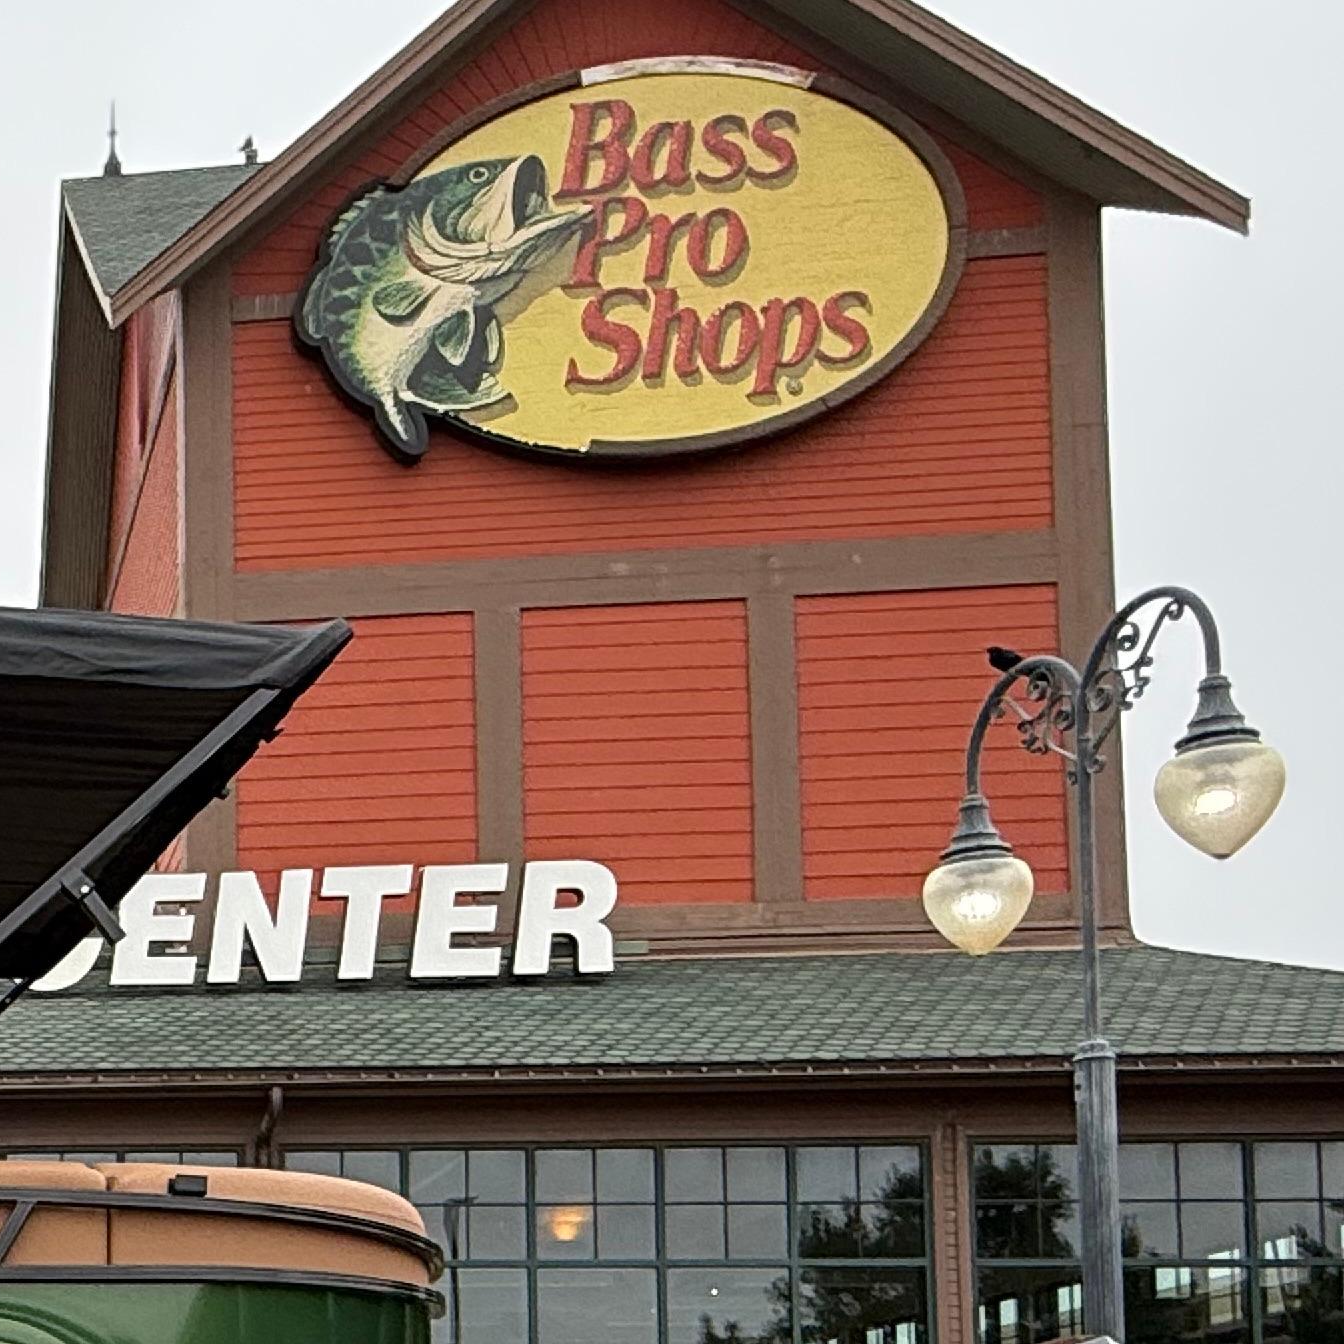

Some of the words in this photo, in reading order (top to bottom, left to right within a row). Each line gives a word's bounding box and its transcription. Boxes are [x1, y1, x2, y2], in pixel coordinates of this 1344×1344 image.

[554, 99, 799, 200] Bass
[562, 198, 750, 290] Pro
[565, 288, 872, 402] Shops
